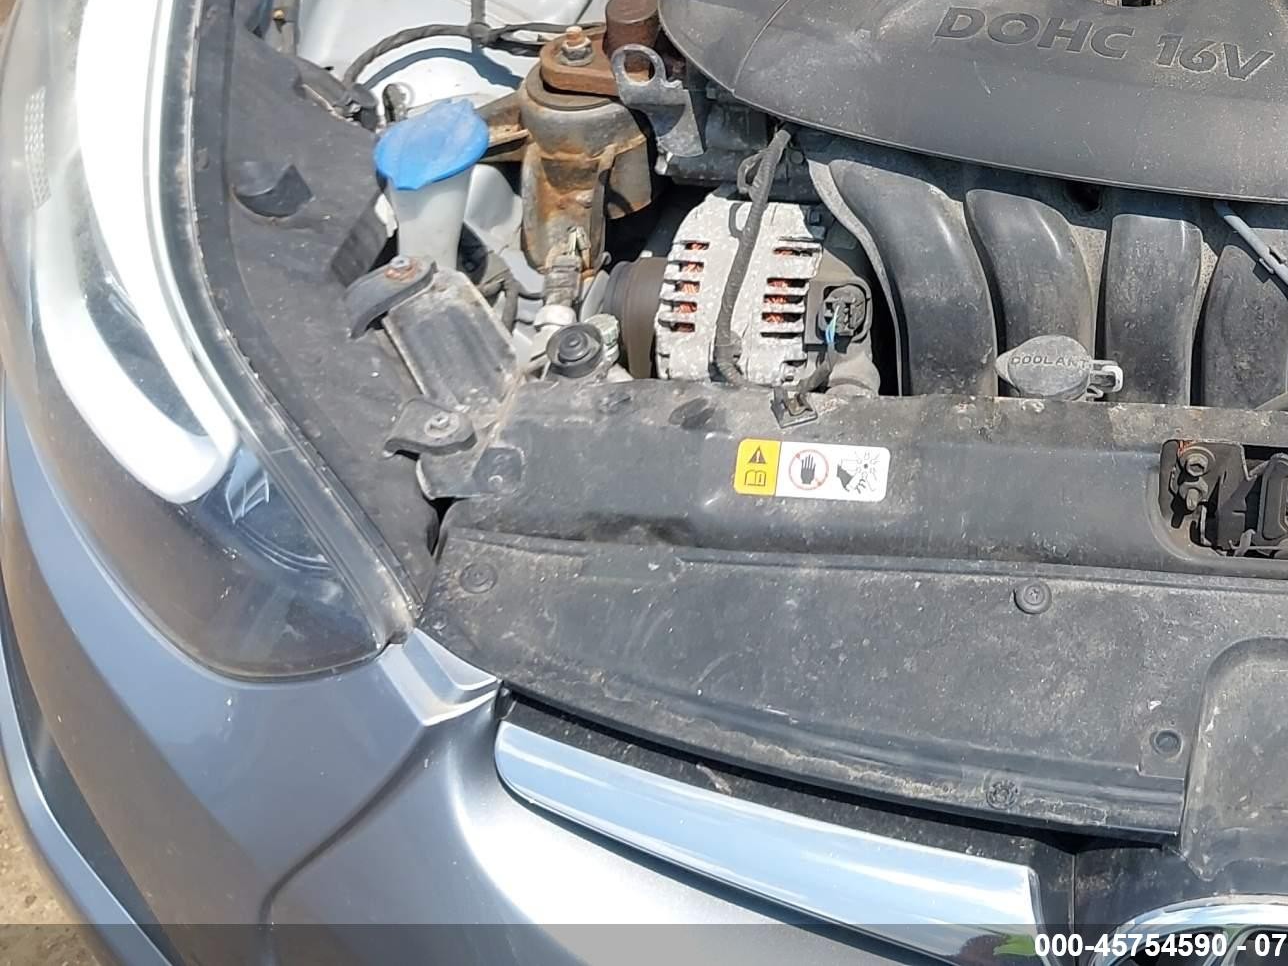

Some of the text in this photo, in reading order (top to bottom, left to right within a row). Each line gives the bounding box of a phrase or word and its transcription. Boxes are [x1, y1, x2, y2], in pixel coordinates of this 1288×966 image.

[934, 6, 1275, 81] DOHC 16V
[1010, 355, 1088, 370] COOLANT
